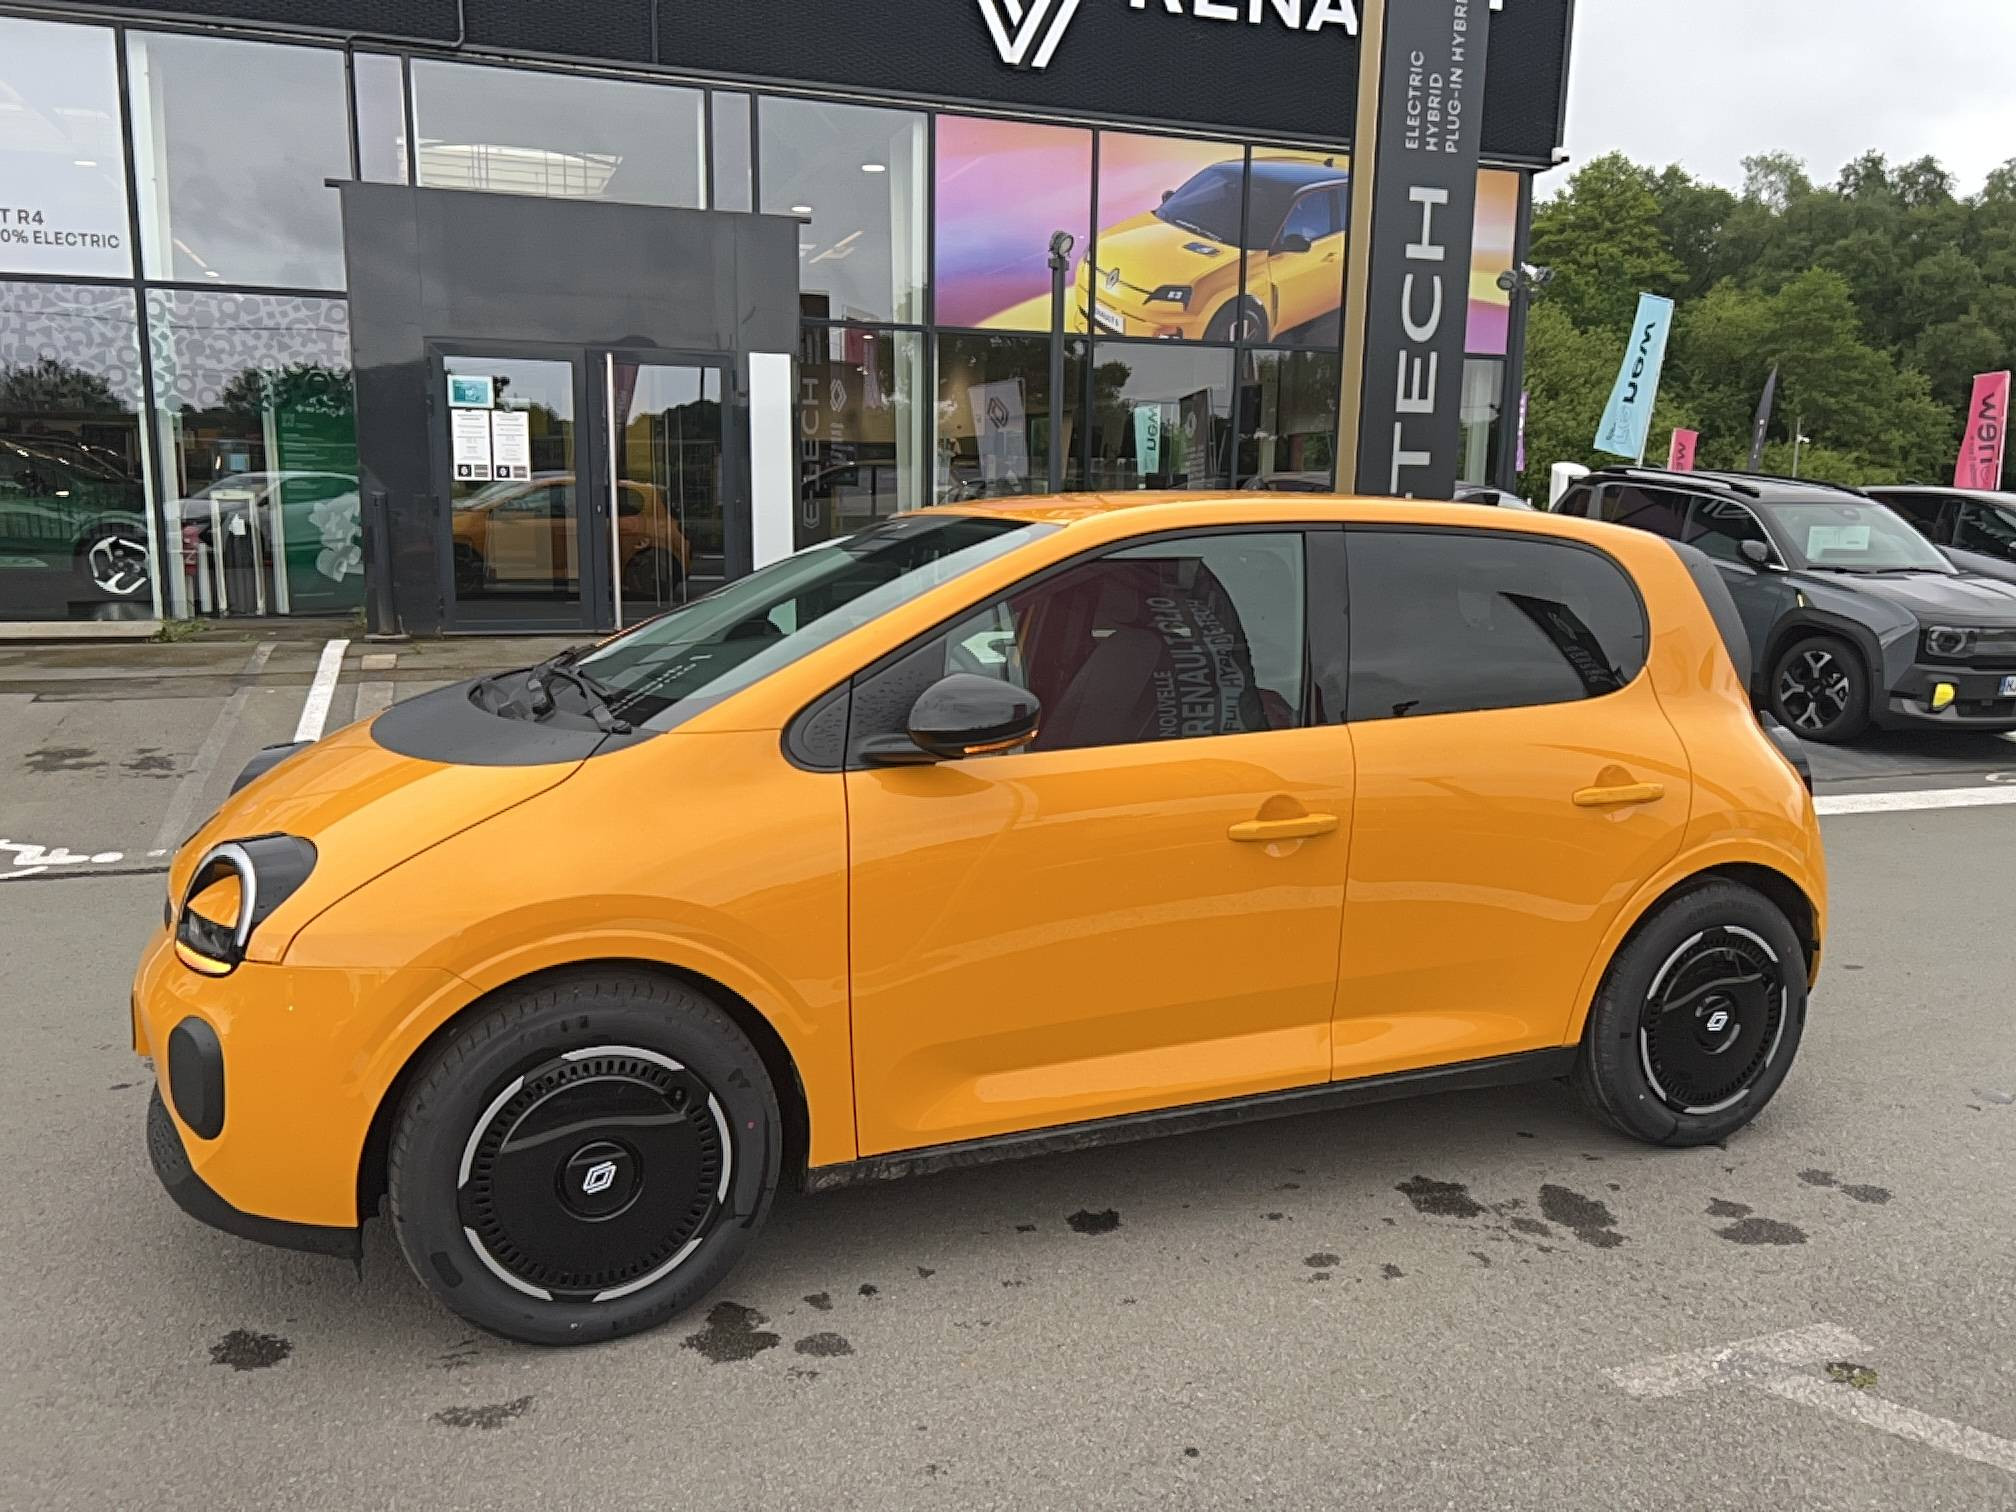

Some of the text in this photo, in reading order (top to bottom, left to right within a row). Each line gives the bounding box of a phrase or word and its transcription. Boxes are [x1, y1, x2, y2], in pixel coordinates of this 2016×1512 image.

[1404, 50, 1425, 149] ELECTRIC
[1425, 72, 1443, 151] HYBRID
[1444, 0, 1469, 154] PLUG-IN HYBRI
[0, 208, 44, 225] T R4
[0, 228, 120, 249] 0% ELECTRIC
[1391, 185, 1449, 498] TECH
[1164, 636, 1216, 738] RENAULT
